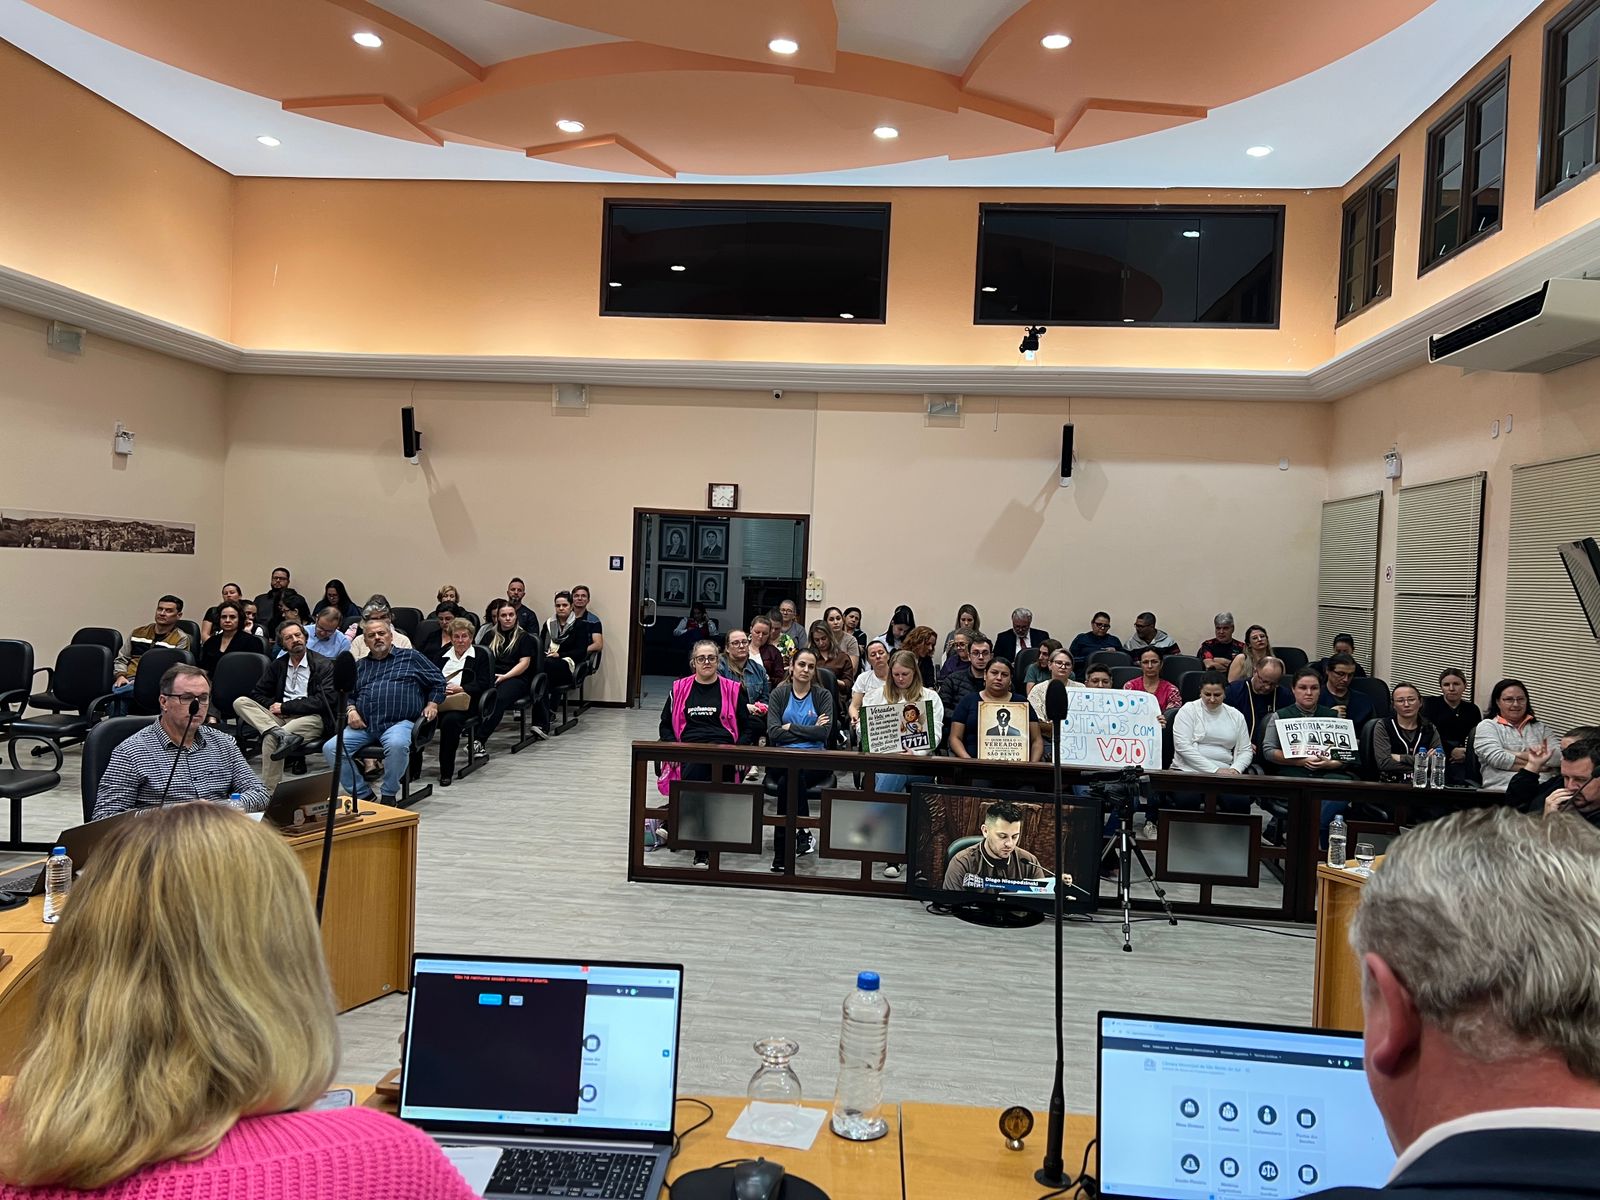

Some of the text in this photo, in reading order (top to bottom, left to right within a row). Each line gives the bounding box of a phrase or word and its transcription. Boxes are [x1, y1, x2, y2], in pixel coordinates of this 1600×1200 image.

[1133, 724, 1155, 737] COM
[901, 735, 928, 748] 17171
[985, 876, 1001, 884] Diego
